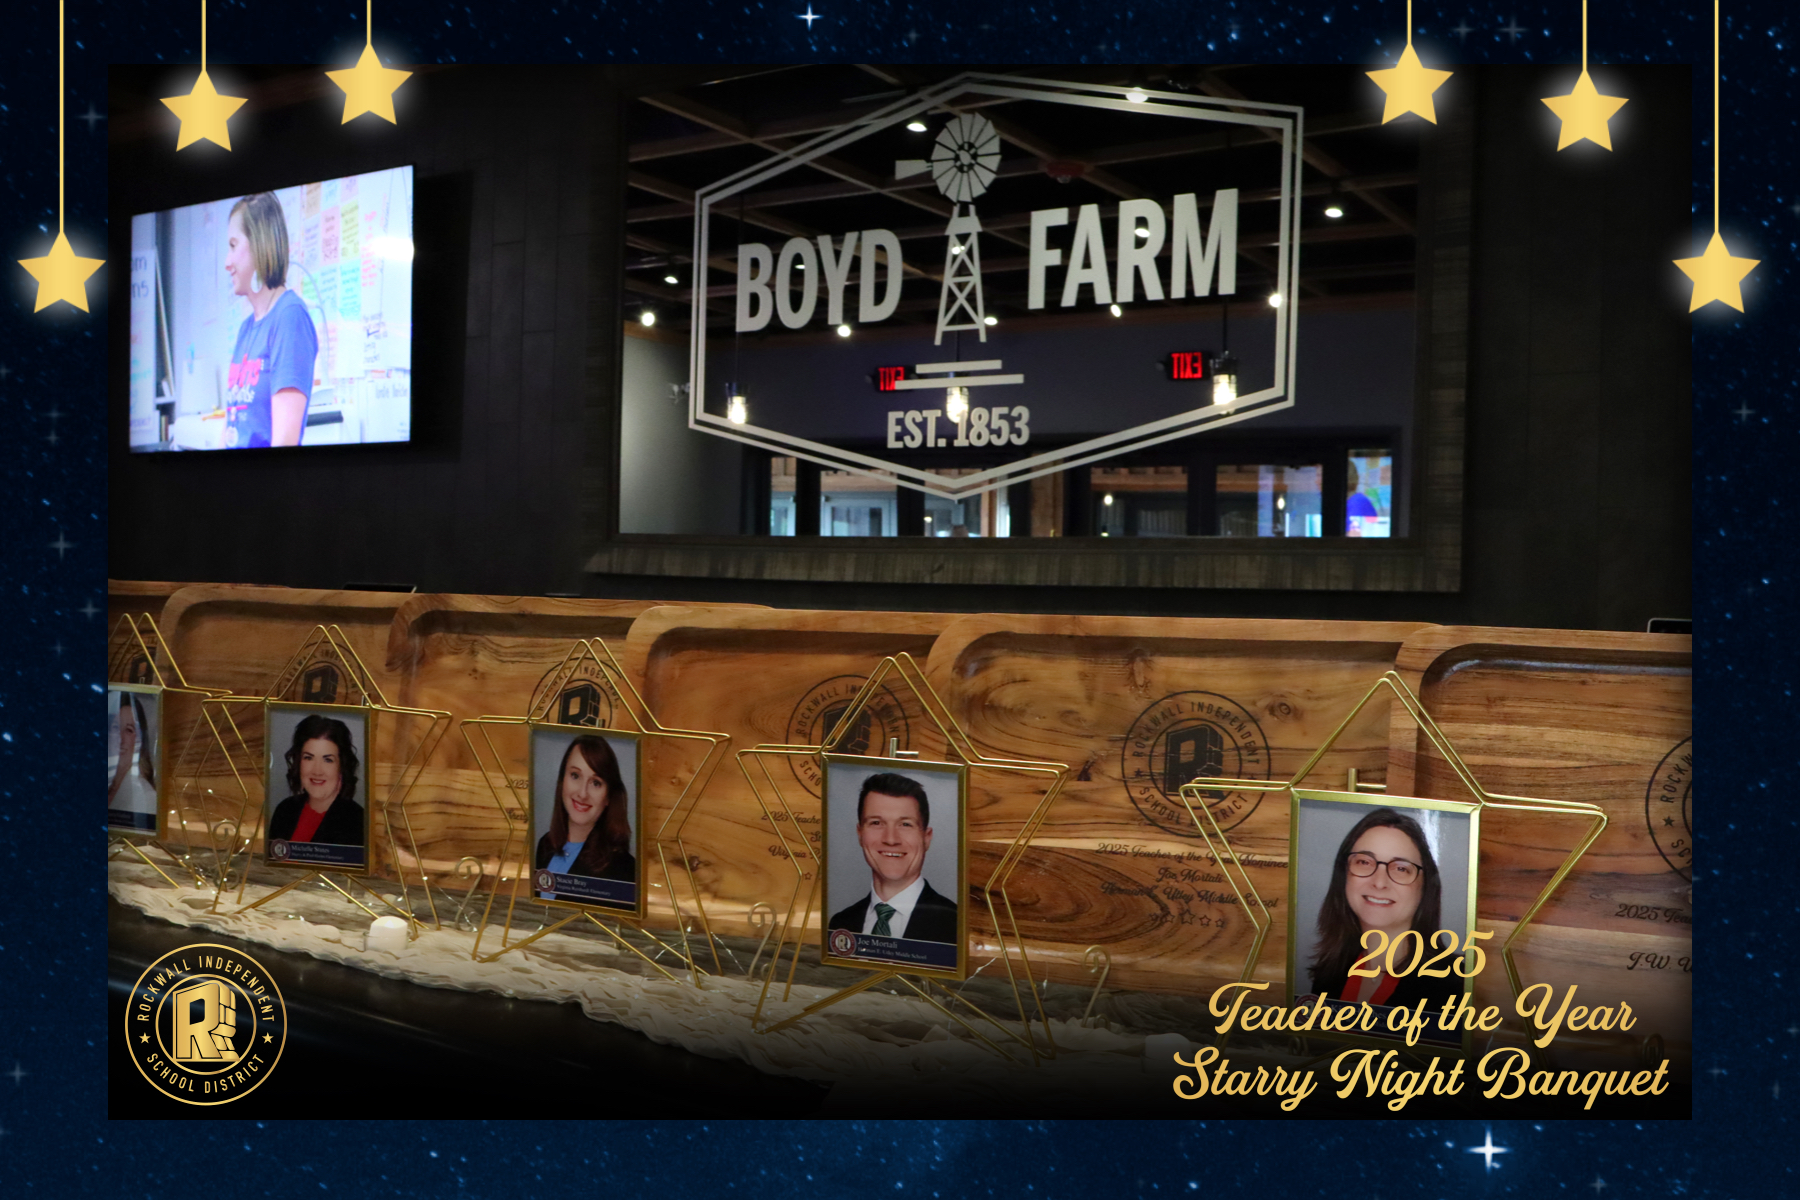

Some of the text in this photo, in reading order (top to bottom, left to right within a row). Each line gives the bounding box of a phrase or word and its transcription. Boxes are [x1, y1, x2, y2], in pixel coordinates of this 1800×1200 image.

[735, 188, 1238, 332] BOYD FARM
[887, 405, 1030, 449] EST. 1853
[795, 687, 839, 738] ROCKWALL
[1132, 701, 1260, 765] ROCKWALL INDEPENDENT
[1139, 787, 1181, 825] SCHOOL
[1095, 843, 1129, 856] 2025
[1132, 845, 1171, 859] Teacher
[1174, 851, 1184, 863] of
[1186, 850, 1202, 862] the
[1239, 853, 1288, 868] Nominee
[1155, 867, 1223, 884] Joe Mortali
[1163, 886, 1194, 904] Utley
[1198, 890, 1238, 904] Middle
[1615, 903, 1661, 920] 2025
[857, 937, 898, 949] Joe Mortali
